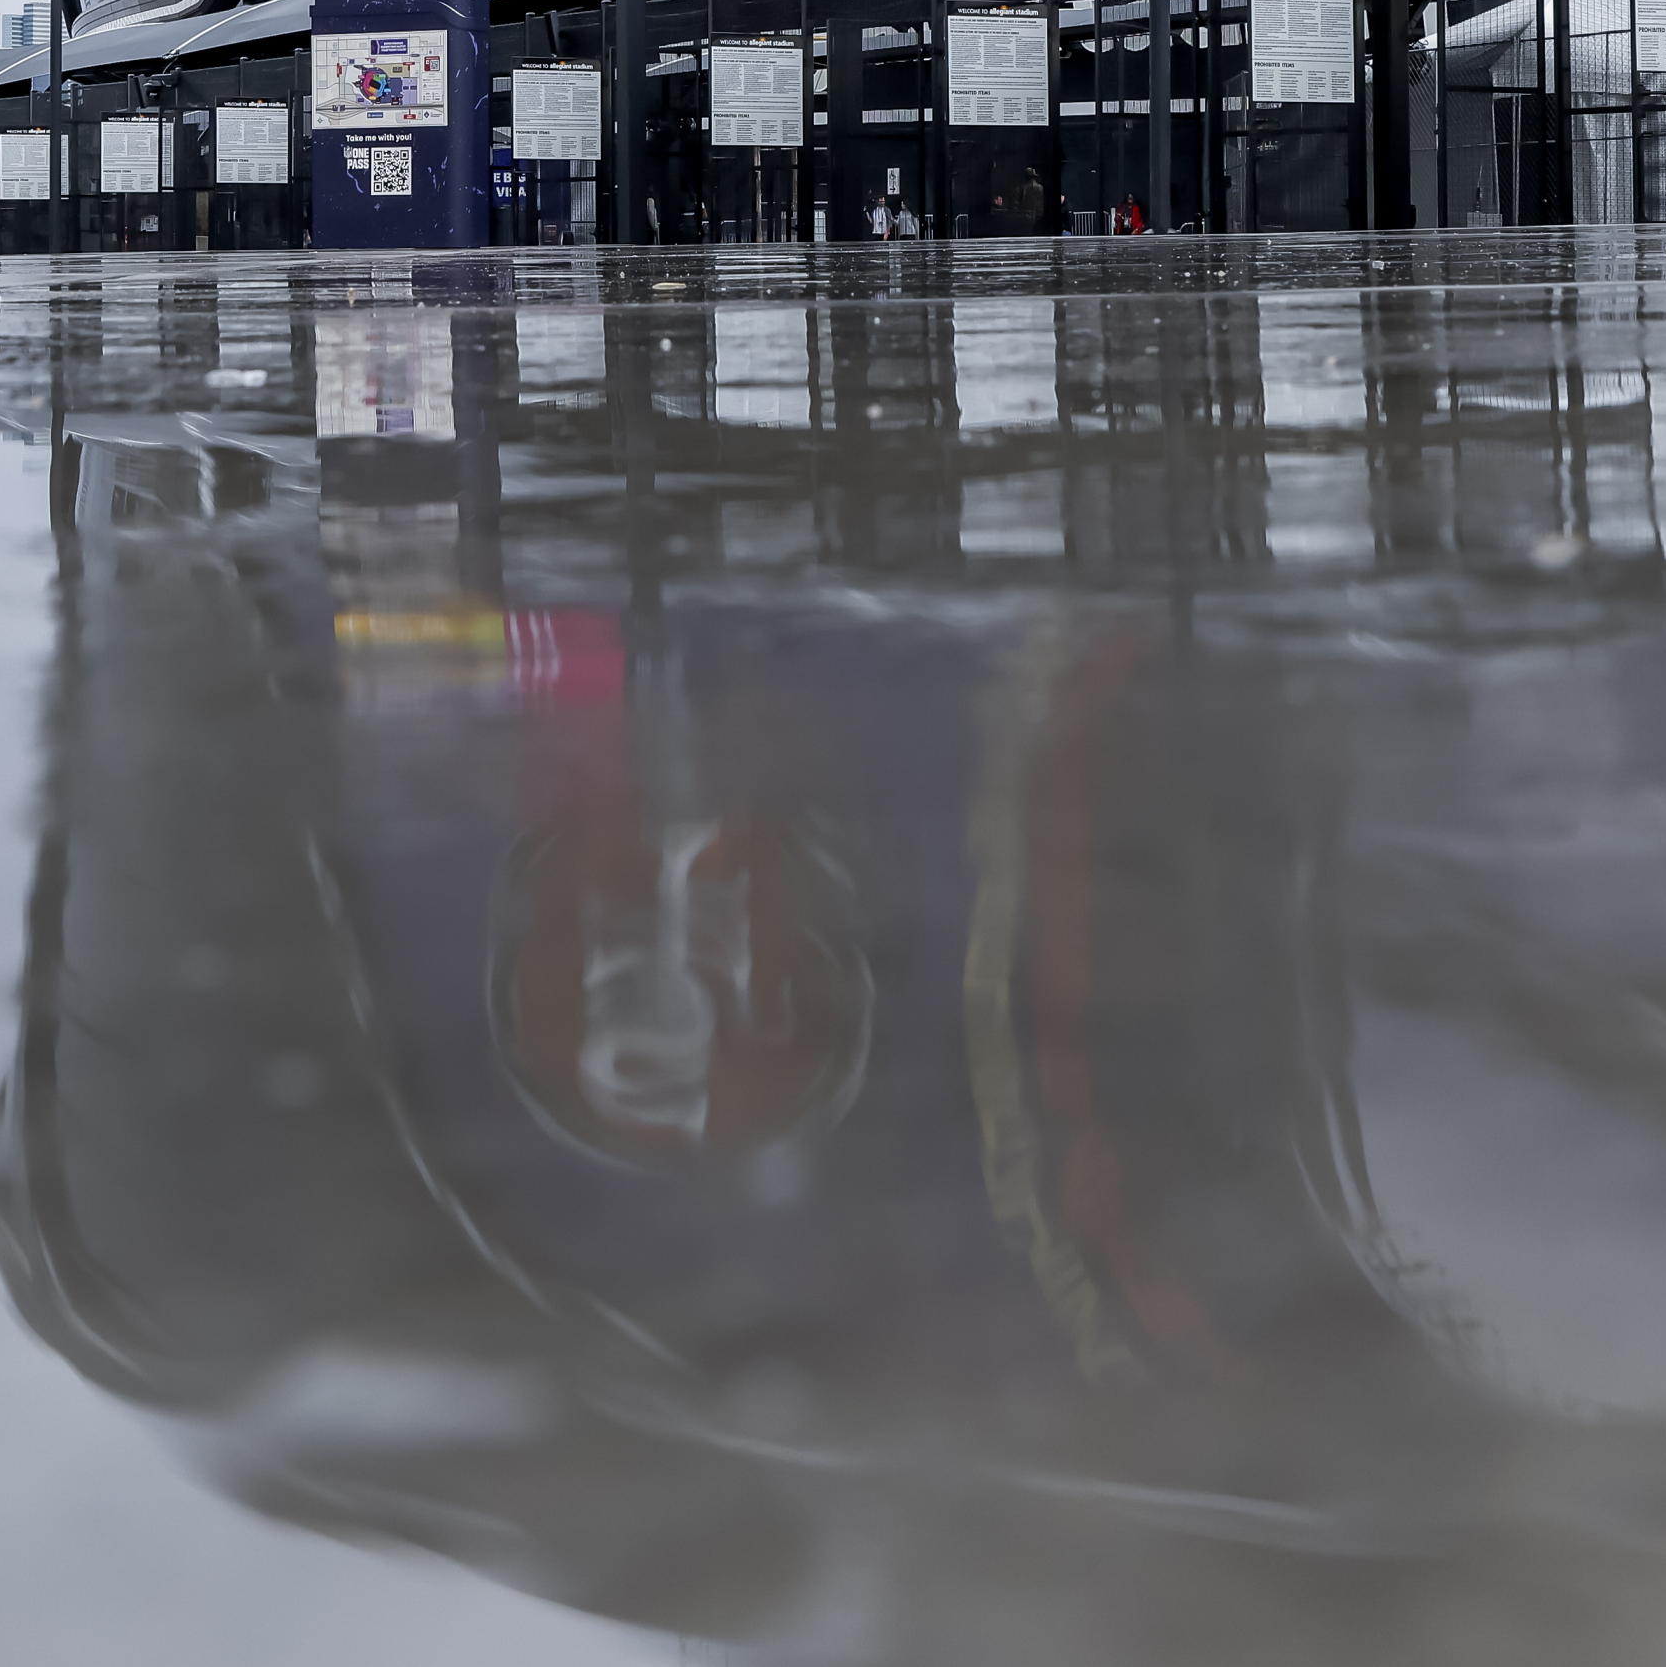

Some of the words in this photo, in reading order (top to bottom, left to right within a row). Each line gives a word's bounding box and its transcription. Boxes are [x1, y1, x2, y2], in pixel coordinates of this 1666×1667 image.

[989, 7, 1014, 17] allegiant
[749, 38, 772, 47] allegiant
[550, 62, 572, 71] allegiant
[345, 134, 364, 142] Take
[378, 133, 394, 141] with
[395, 133, 412, 143] you!
[353, 147, 370, 159] ONE
[347, 158, 370, 170] PASS
